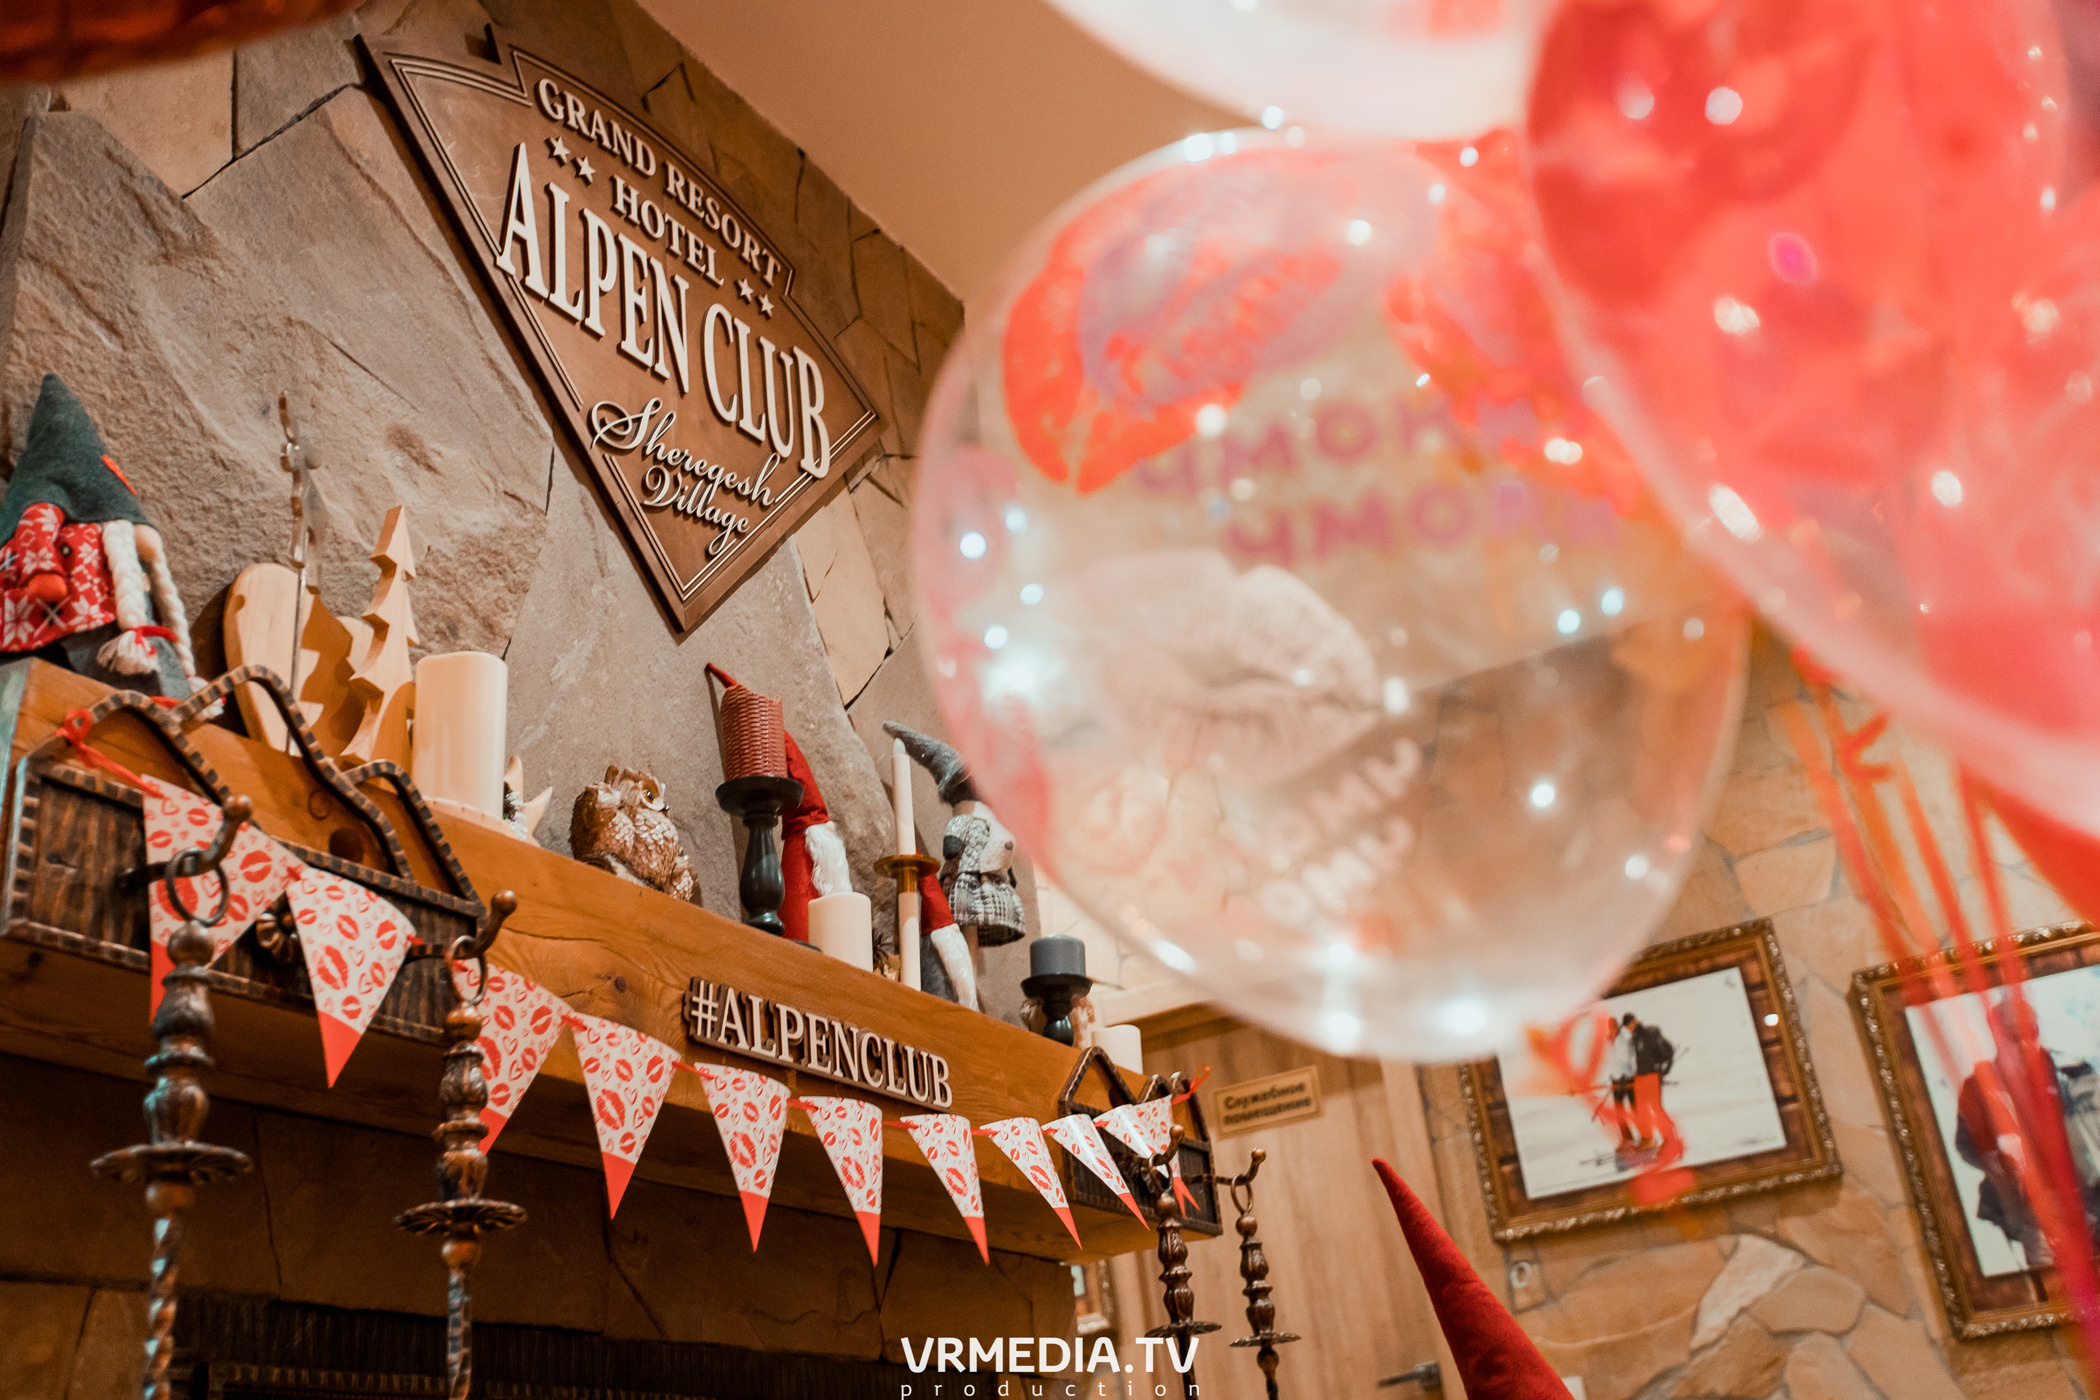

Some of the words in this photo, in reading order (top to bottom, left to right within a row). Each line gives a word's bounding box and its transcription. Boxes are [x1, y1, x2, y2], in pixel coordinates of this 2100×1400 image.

[538, 78, 657, 177] GRAND
[664, 161, 782, 286] RESORT
[609, 176, 725, 287] HOTEL
[497, 142, 690, 393] ALPEN
[703, 303, 831, 479] CLUB
[590, 397, 780, 507] Sheregesh
[643, 465, 750, 556] Village
[690, 979, 953, 1109] #ALPENCLUB
